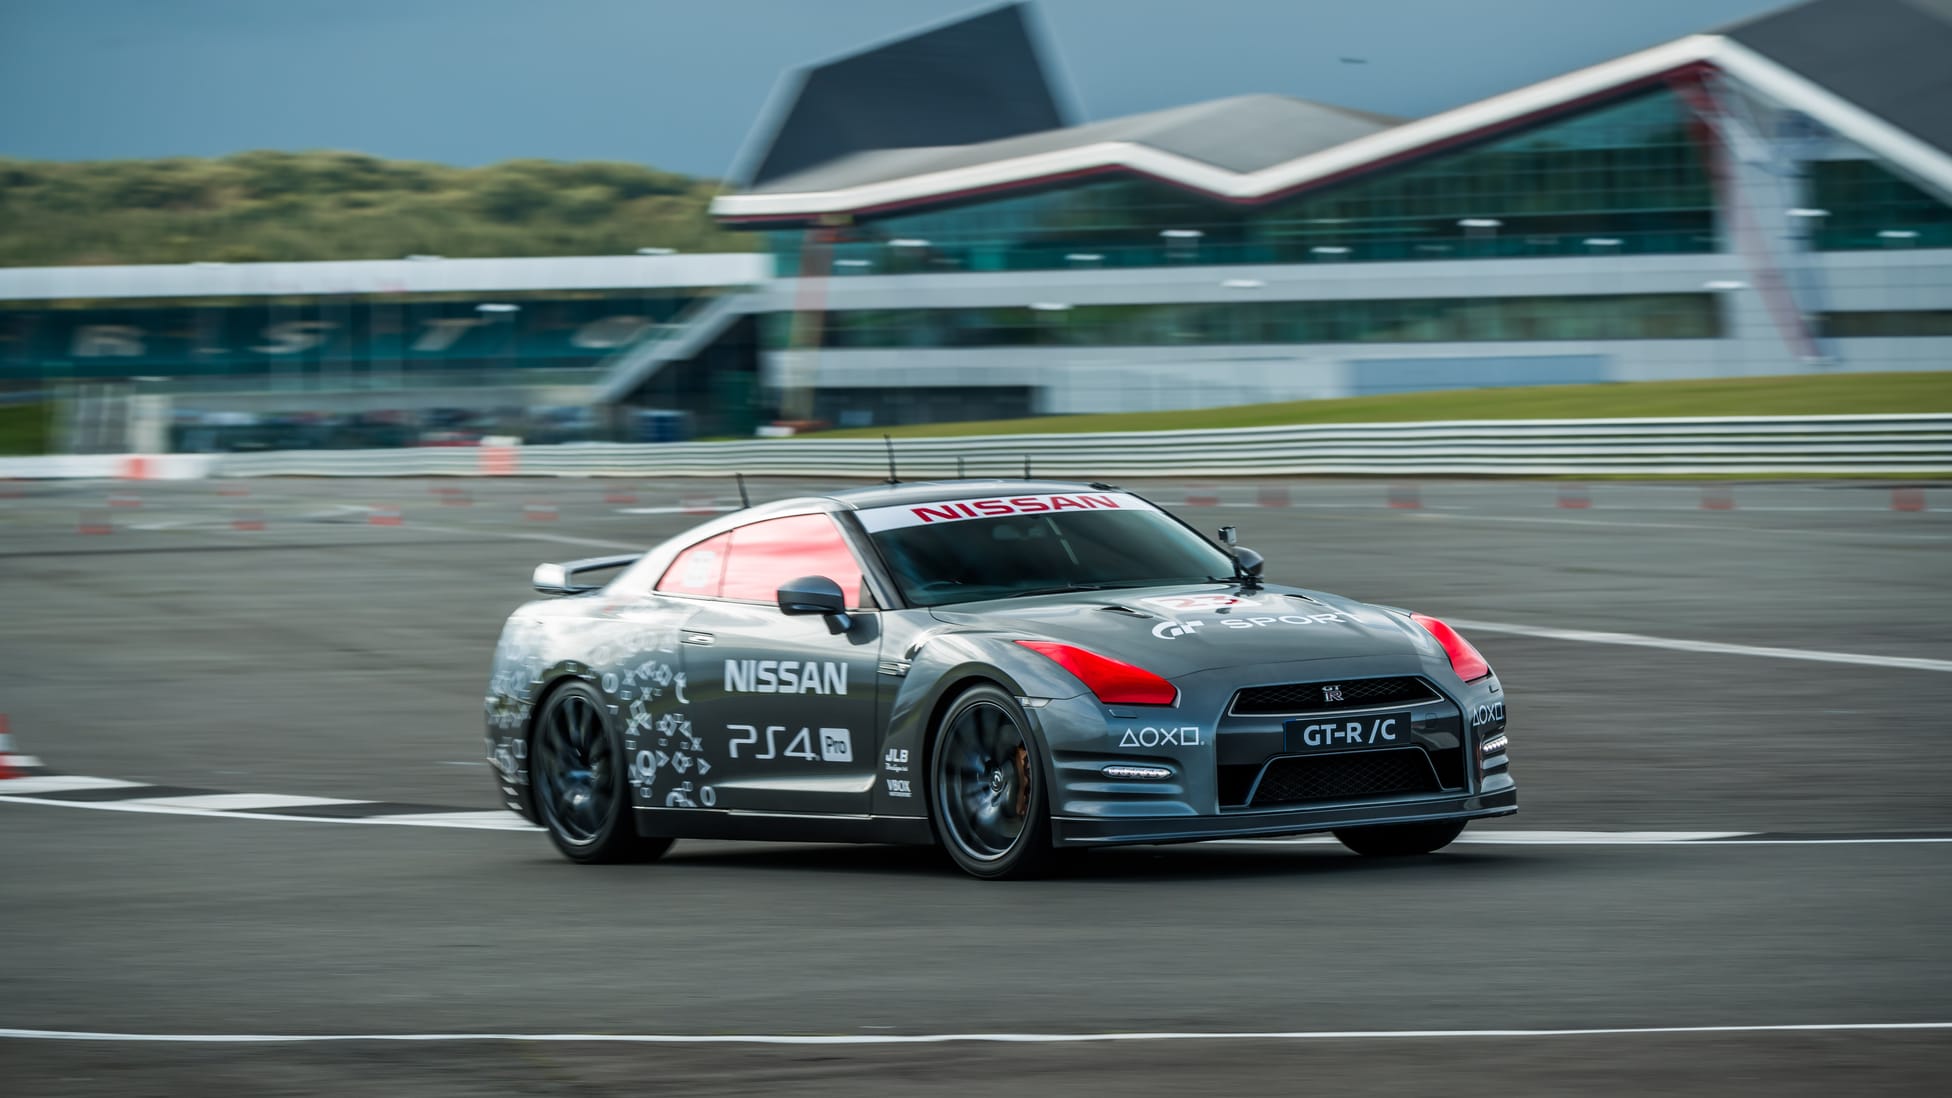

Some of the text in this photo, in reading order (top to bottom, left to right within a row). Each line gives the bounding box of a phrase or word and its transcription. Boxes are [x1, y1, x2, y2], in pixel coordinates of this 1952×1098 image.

[911, 494, 1120, 522] NISSAN
[1220, 611, 1364, 629] SPORT
[724, 659, 848, 695] NISSAN
[726, 724, 847, 761] PS4 Pro
[1303, 719, 1396, 746] GT-R /C
[885, 748, 909, 762] JLB
